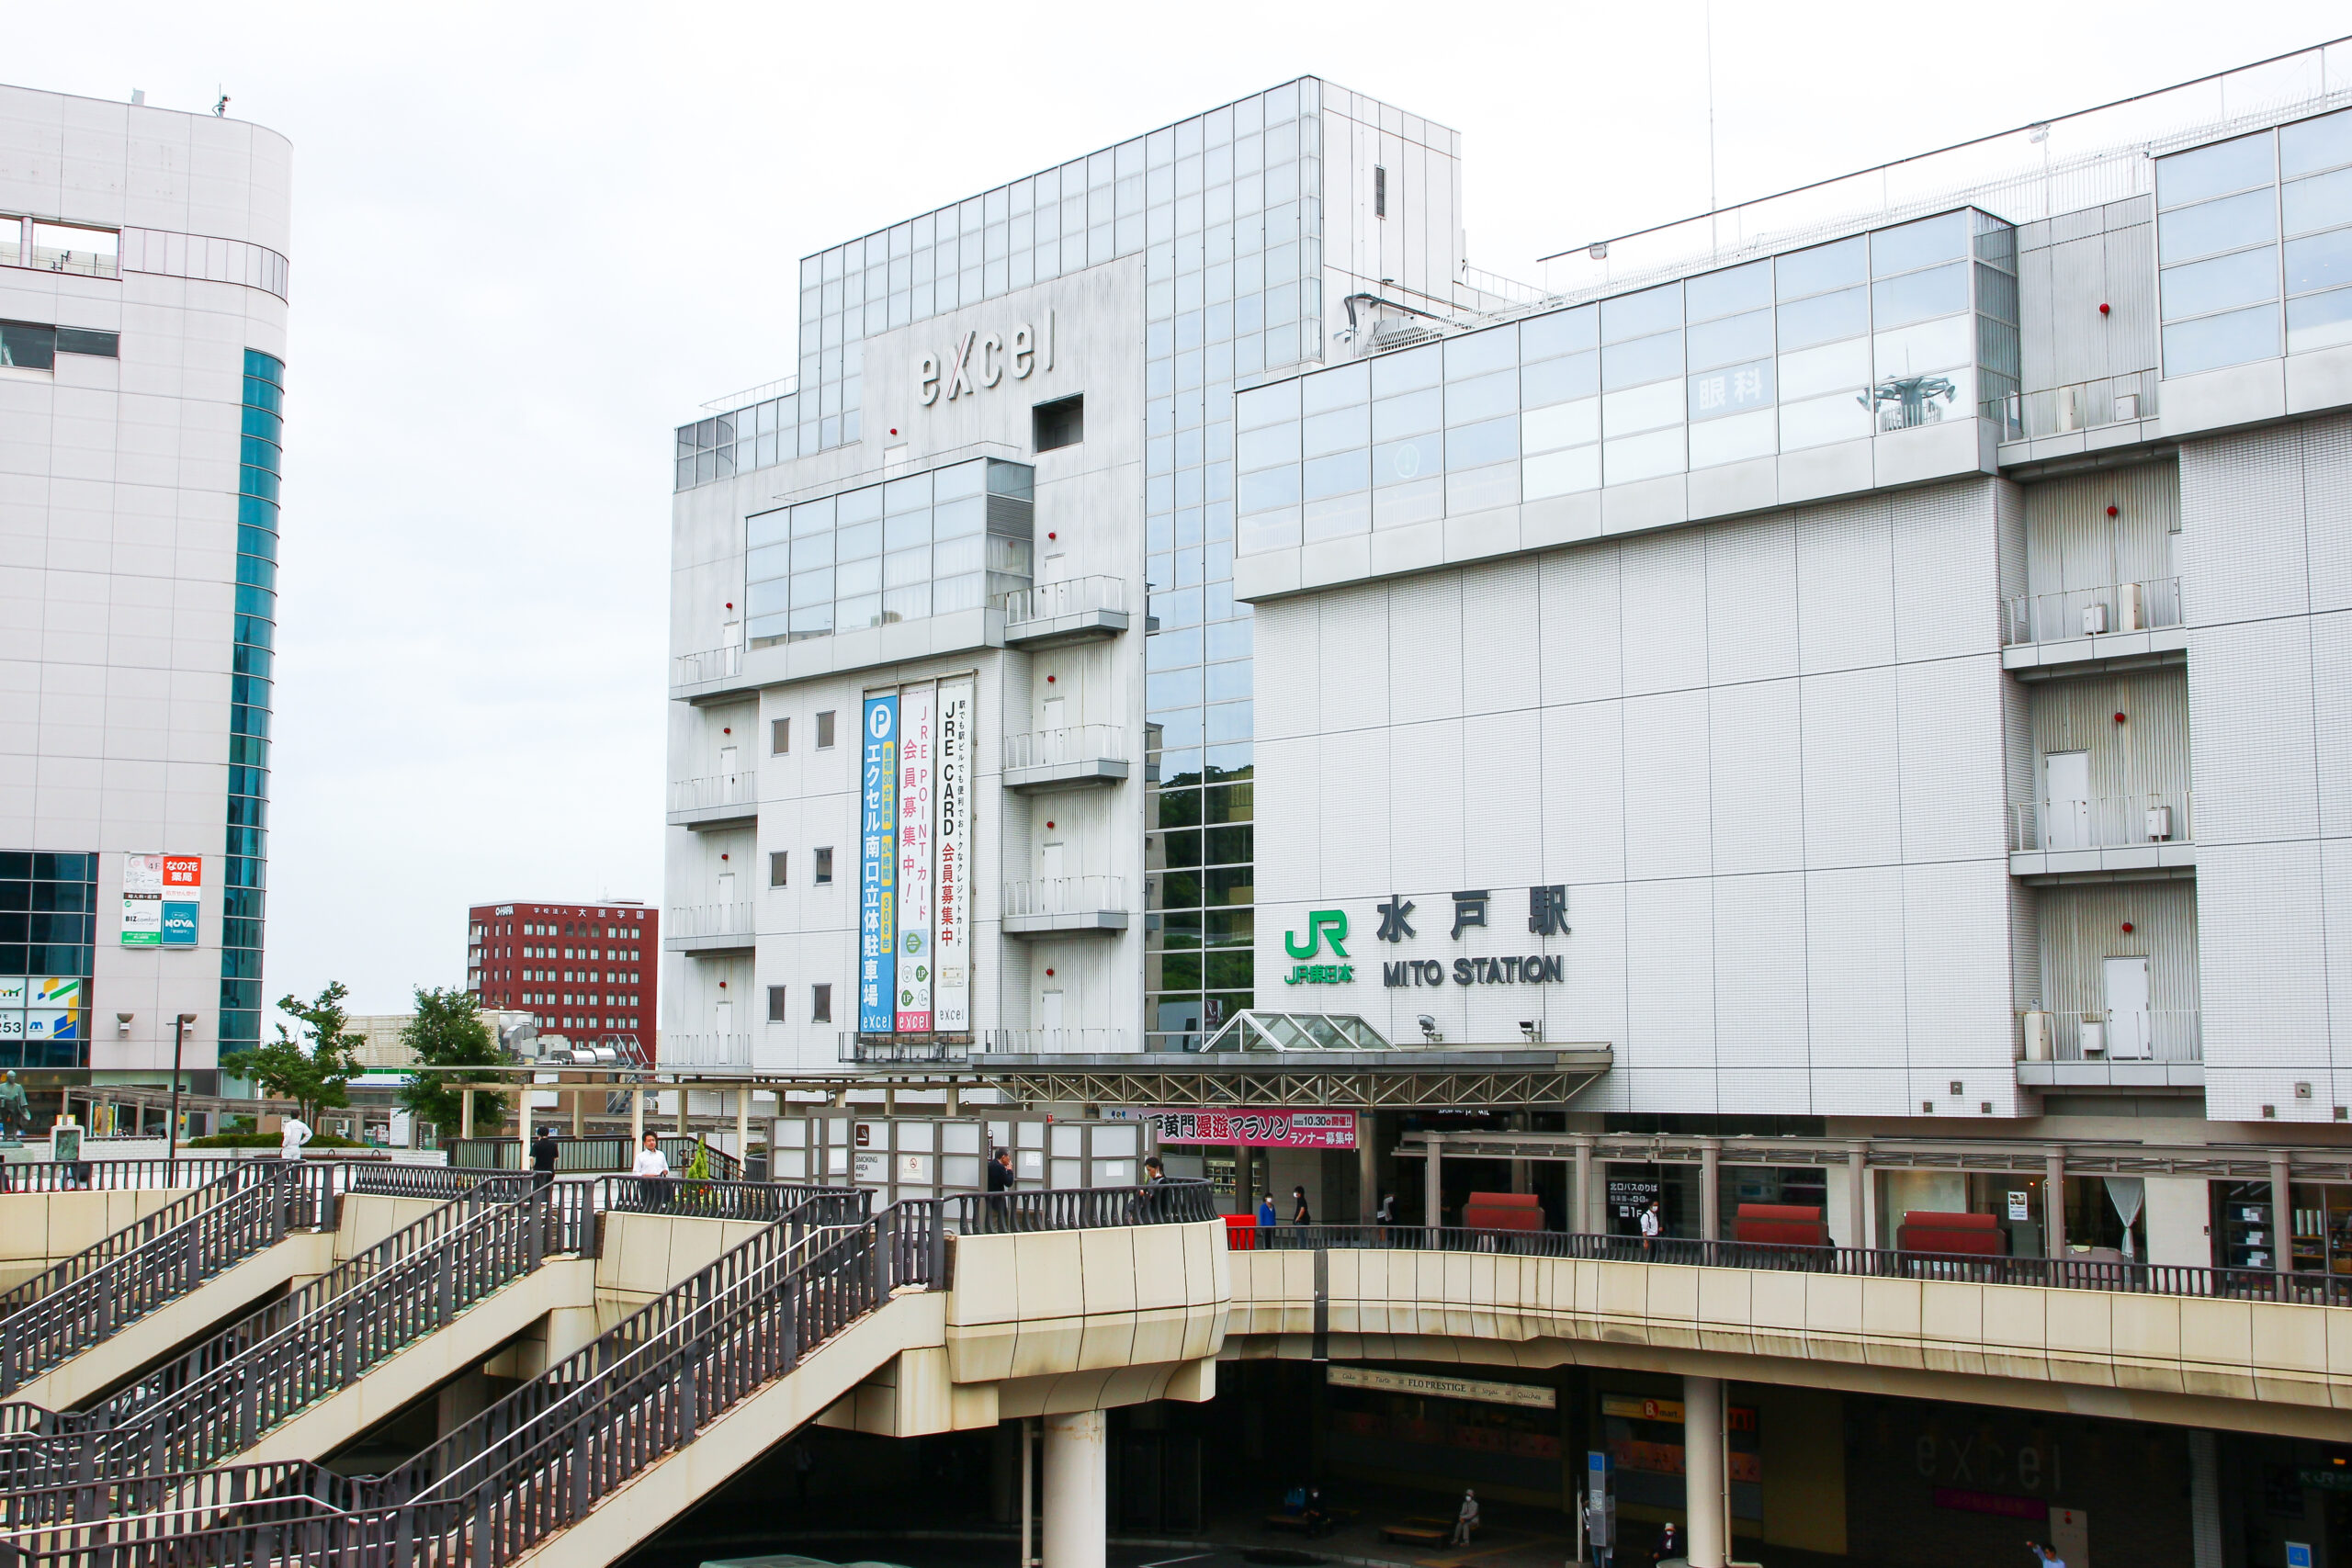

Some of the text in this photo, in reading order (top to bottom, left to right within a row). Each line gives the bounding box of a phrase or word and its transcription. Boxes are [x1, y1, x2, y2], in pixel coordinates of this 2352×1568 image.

[919, 307, 1055, 406] excel
[1698, 367, 1763, 410] 眼科
[919, 770, 928, 857] POINT
[941, 701, 956, 947] JRE CARD 会員募集中
[166, 862, 198, 872] なの花
[863, 744, 881, 1008] エクセル南口立体駐車場
[171, 872, 193, 882] 薬局
[917, 866, 927, 921] カード
[164, 919, 195, 928] NOVA
[1376, 885, 1571, 943] 水戸駅
[1285, 909, 1350, 958] JR
[1284, 964, 1354, 985] JR東日本
[1384, 954, 1564, 987] MITO STATION
[864, 1013, 891, 1029] excel
[899, 1013, 929, 1030] excel
[940, 1008, 965, 1021] excel
[0, 1021, 21, 1033] 53
[1290, 1132, 1354, 1145] ランナー募集中
[1610, 1183, 1658, 1192] 北口バスのりば
[1630, 1206, 1643, 1218] 1F
[1408, 1378, 1424, 1388] FLO
[1425, 1380, 1467, 1393] PRESTIGE
[1916, 1434, 2062, 1492] excel
